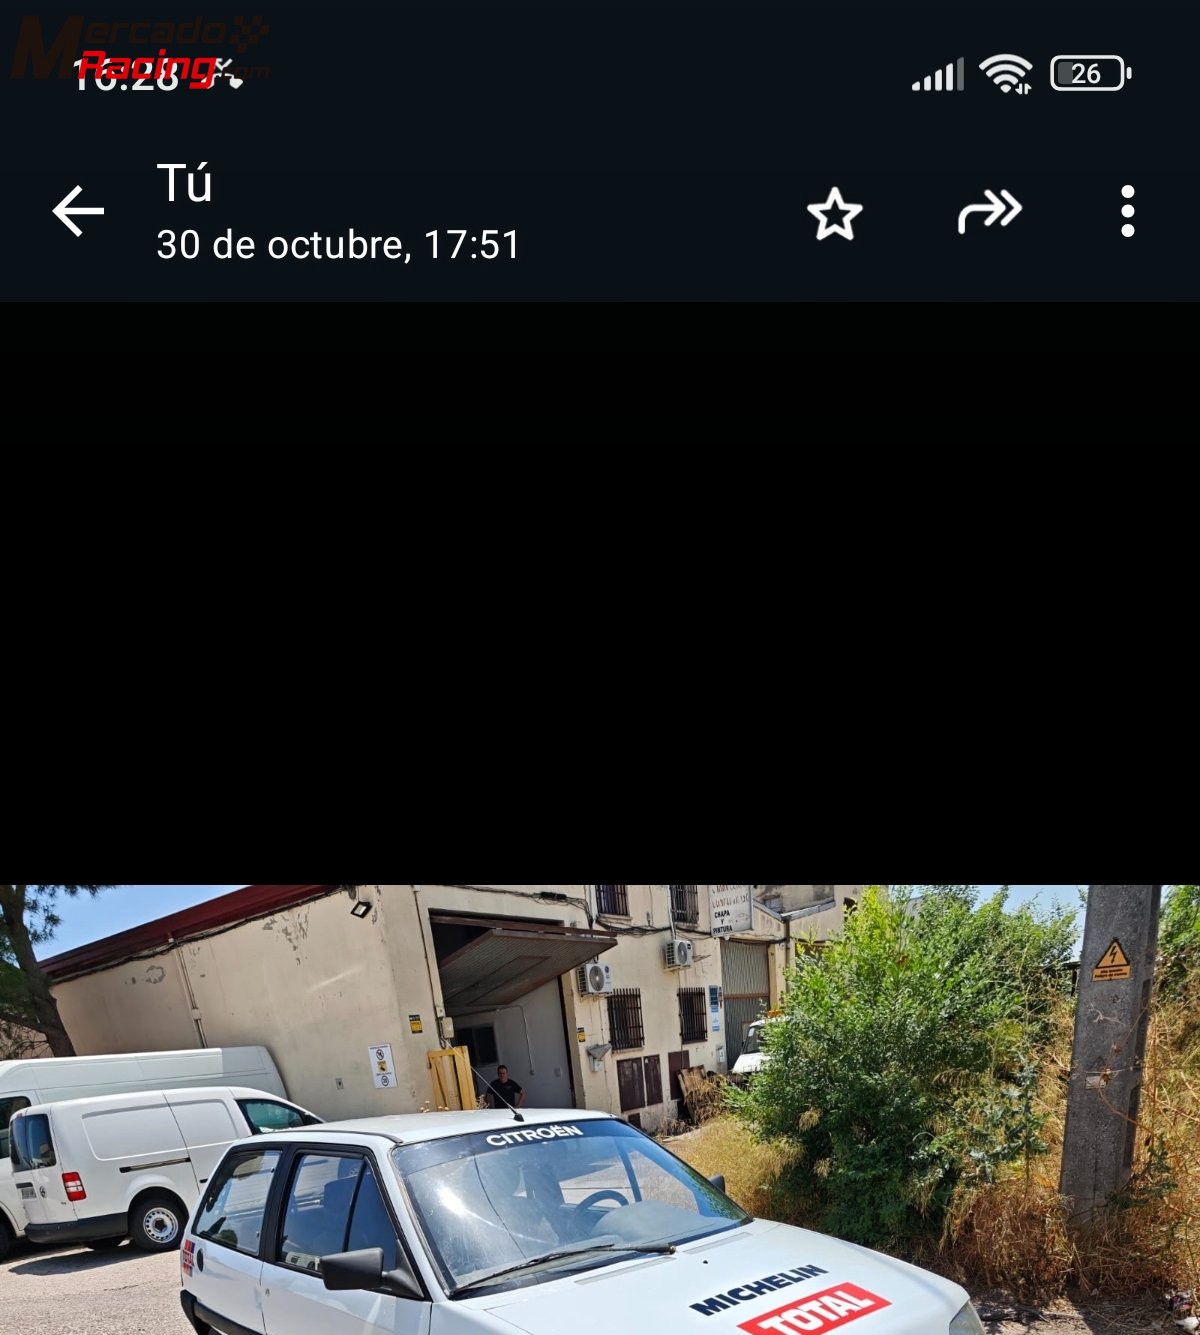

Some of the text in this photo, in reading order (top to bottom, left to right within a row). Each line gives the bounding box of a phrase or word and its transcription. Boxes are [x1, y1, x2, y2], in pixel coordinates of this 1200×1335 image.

[1071, 63, 1101, 84] 26
[157, 162, 212, 203] Tú
[157, 227, 518, 265] 30 de octubre, 17:51
[714, 909, 730, 919] CHAPA
[712, 924, 733, 934] PINTURA
[486, 1125, 584, 1146] CITROËN
[688, 1264, 829, 1317] MICHELIN
